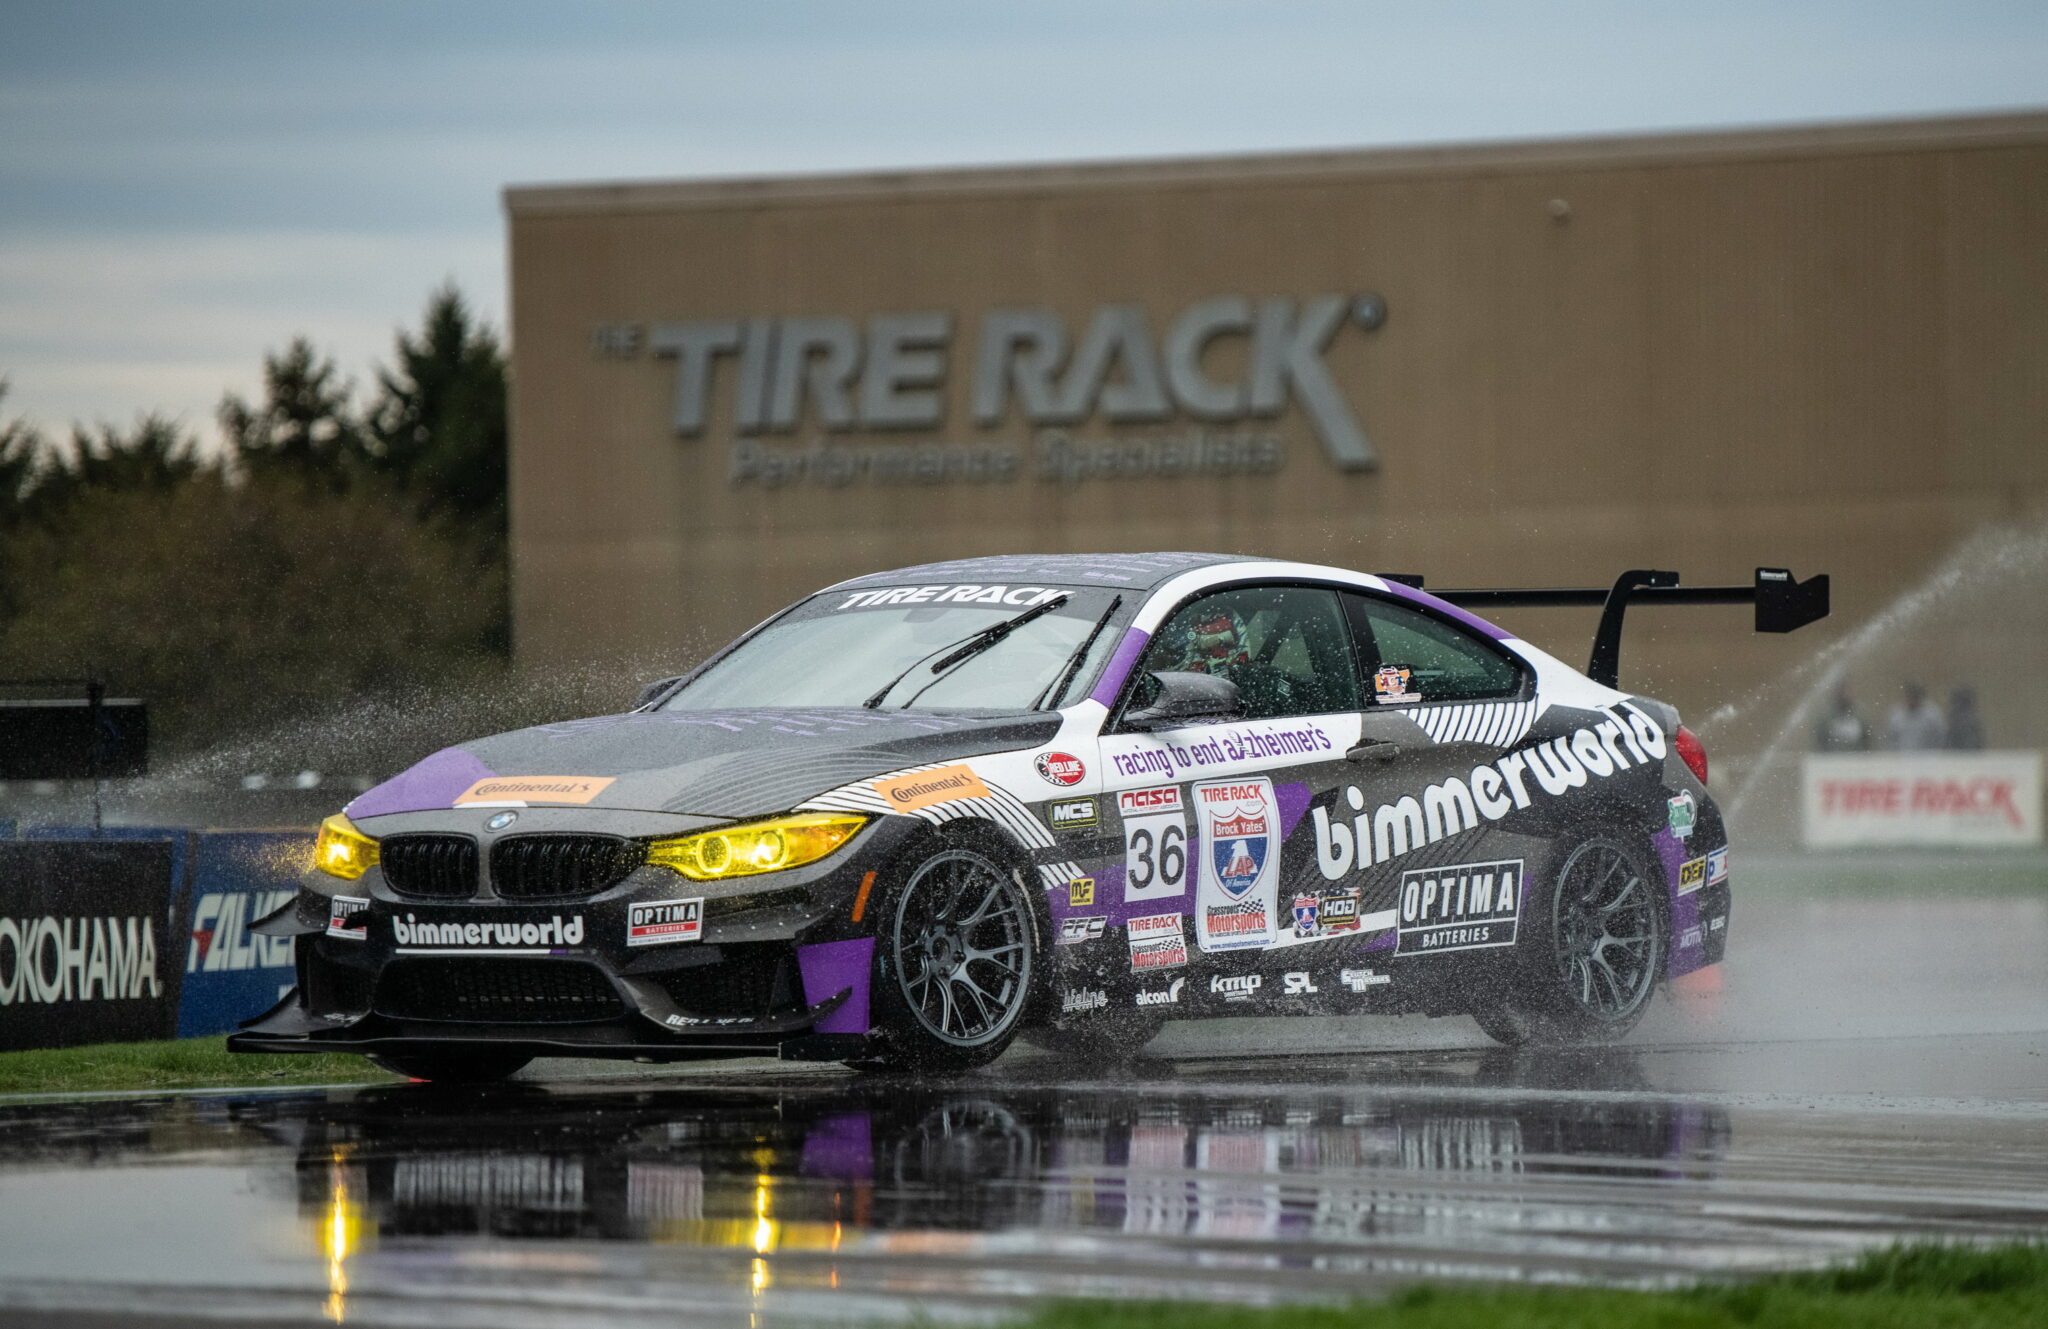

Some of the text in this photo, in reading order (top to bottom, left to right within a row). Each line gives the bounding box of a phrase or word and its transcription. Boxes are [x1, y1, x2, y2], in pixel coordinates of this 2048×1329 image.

[650, 310, 950, 434] TIRE
[974, 294, 1378, 471] RACK
[836, 584, 1075, 610] TIRE RACK
[1112, 744, 1174, 778] racing
[1167, 743, 1192, 767] to
[1192, 736, 1225, 765] end
[475, 782, 579, 796] Continental
[890, 775, 964, 803] Continental
[1201, 785, 1267, 805] TIRE RACK
[1312, 701, 1667, 881] bimmerworld
[1054, 803, 1093, 820] MCS
[1819, 776, 2025, 830] TIRE RACK
[1216, 824, 1239, 835] Brock
[1128, 824, 1185, 889] 36
[1403, 871, 1514, 922] OPTIMA
[633, 904, 697, 926] OPTIMA
[1129, 915, 1180, 932] TIRE RACK
[1207, 912, 1266, 935] Motorsports
[392, 913, 584, 945] bimmerworld
[645, 924, 686, 935] BATTERIES
[1423, 927, 1489, 948] BATTERIES
[1133, 949, 1185, 968] Motorsports
[1136, 989, 1170, 1006] alcon
